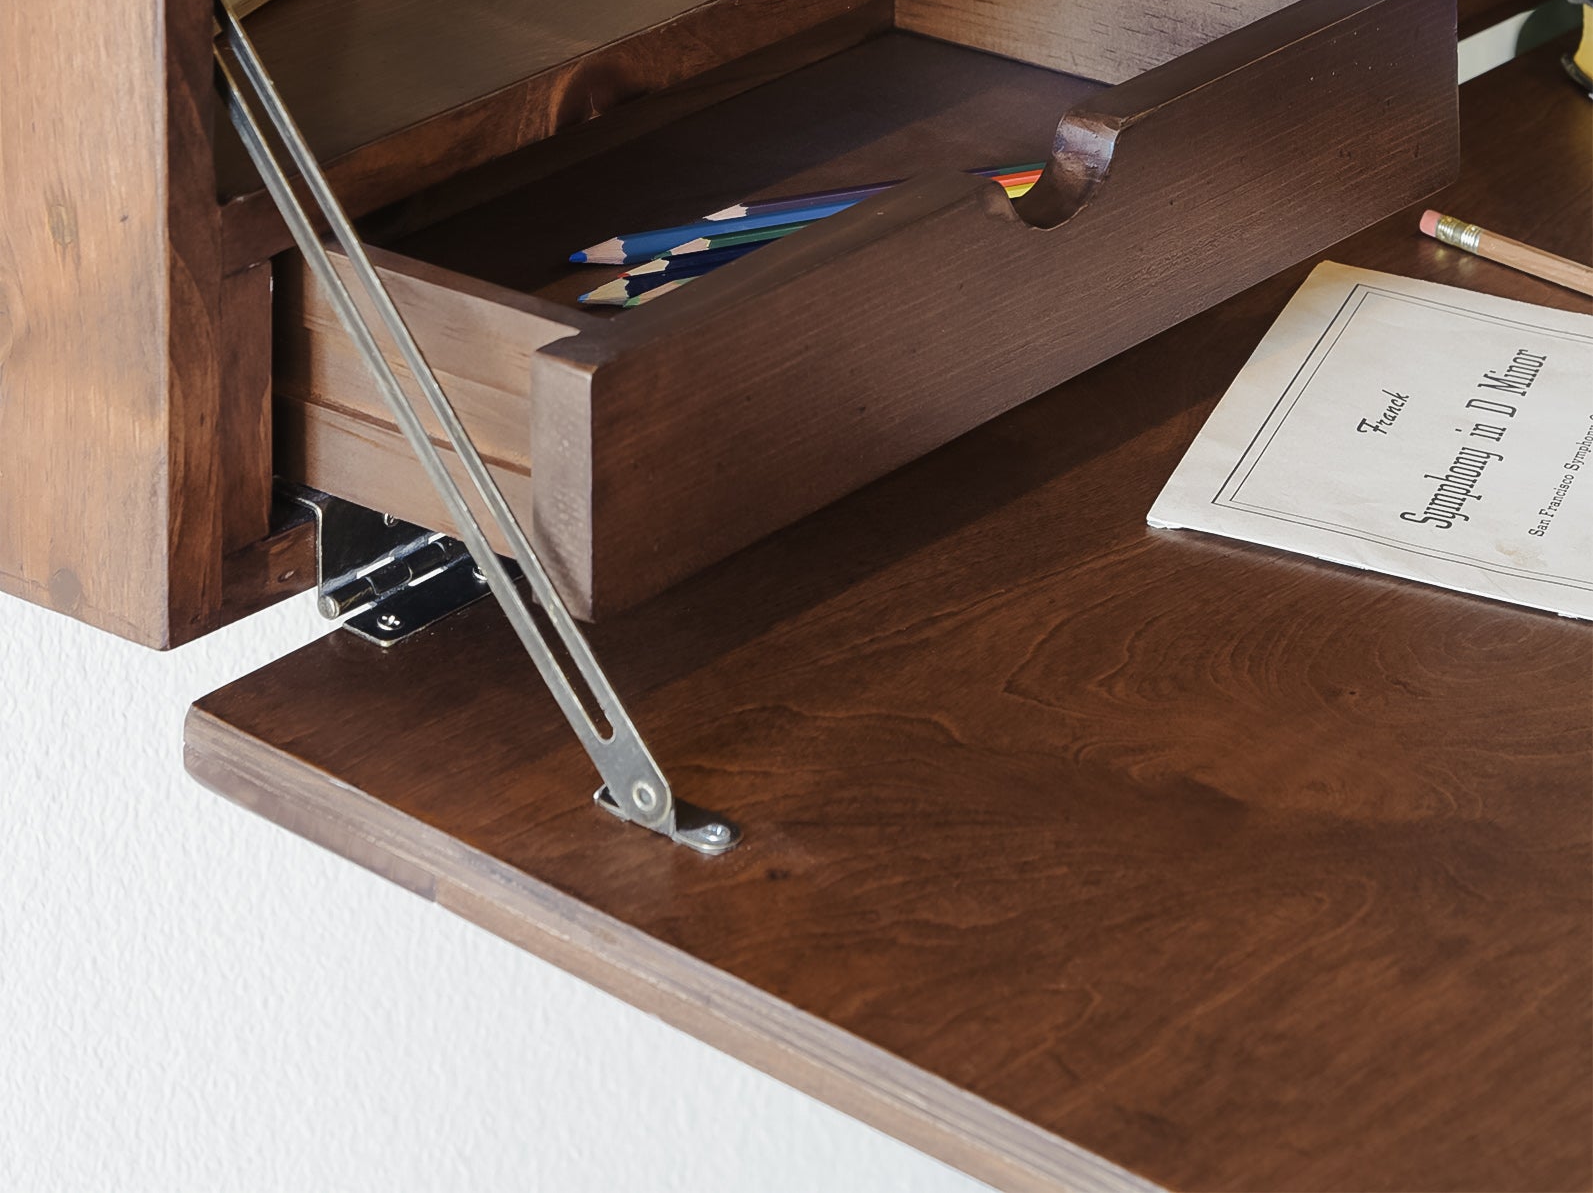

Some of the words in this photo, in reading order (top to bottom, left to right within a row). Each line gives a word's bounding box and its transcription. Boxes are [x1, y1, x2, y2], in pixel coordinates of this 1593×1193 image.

[1477, 348, 1547, 397] Minor
[1356, 389, 1410, 435] Franck
[1465, 398, 1517, 418] D
[1455, 422, 1507, 442] in
[1399, 446, 1504, 530] Symphony
[1538, 474, 1574, 518] Francisco
[1528, 518, 1551, 537] San
